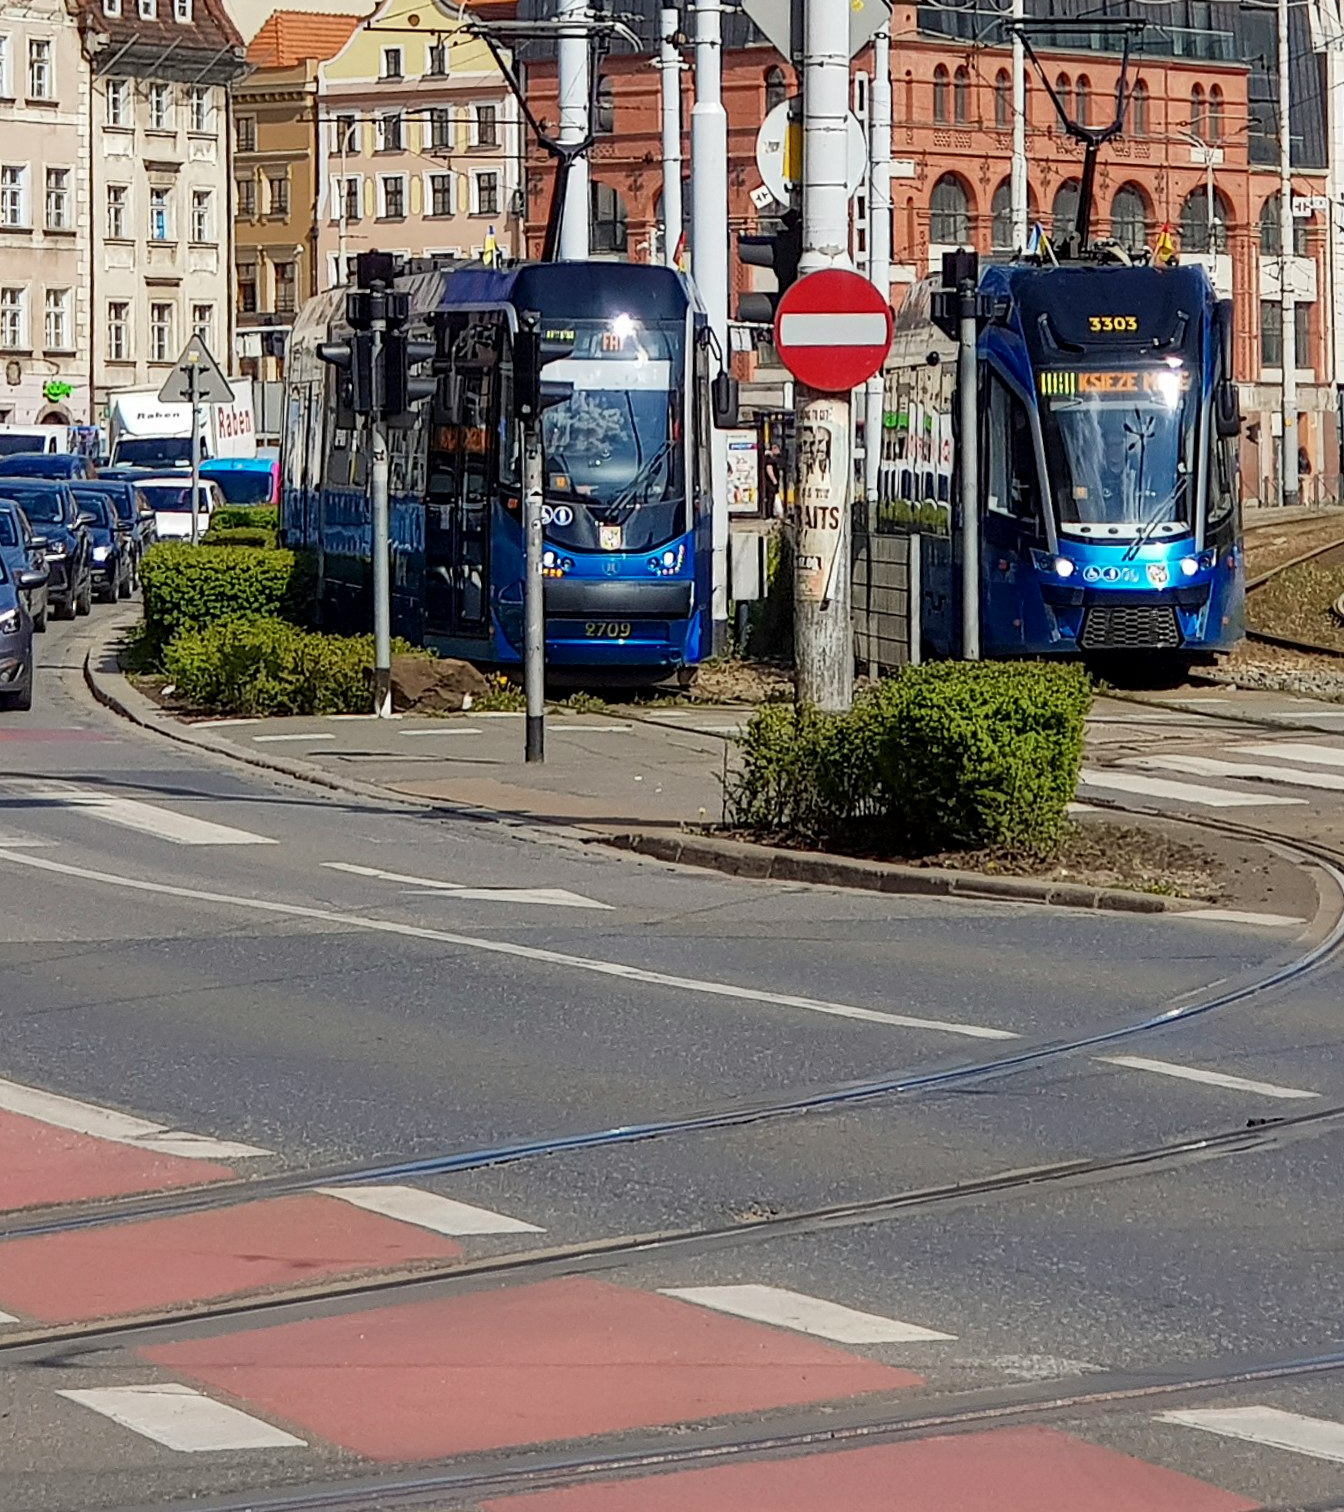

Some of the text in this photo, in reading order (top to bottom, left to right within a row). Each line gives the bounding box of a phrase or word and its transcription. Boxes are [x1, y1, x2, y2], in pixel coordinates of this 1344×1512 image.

[1089, 316, 1138, 331] 3303
[137, 412, 180, 420] Raben
[218, 406, 252, 439] Raben
[585, 622, 631, 637] 2709
